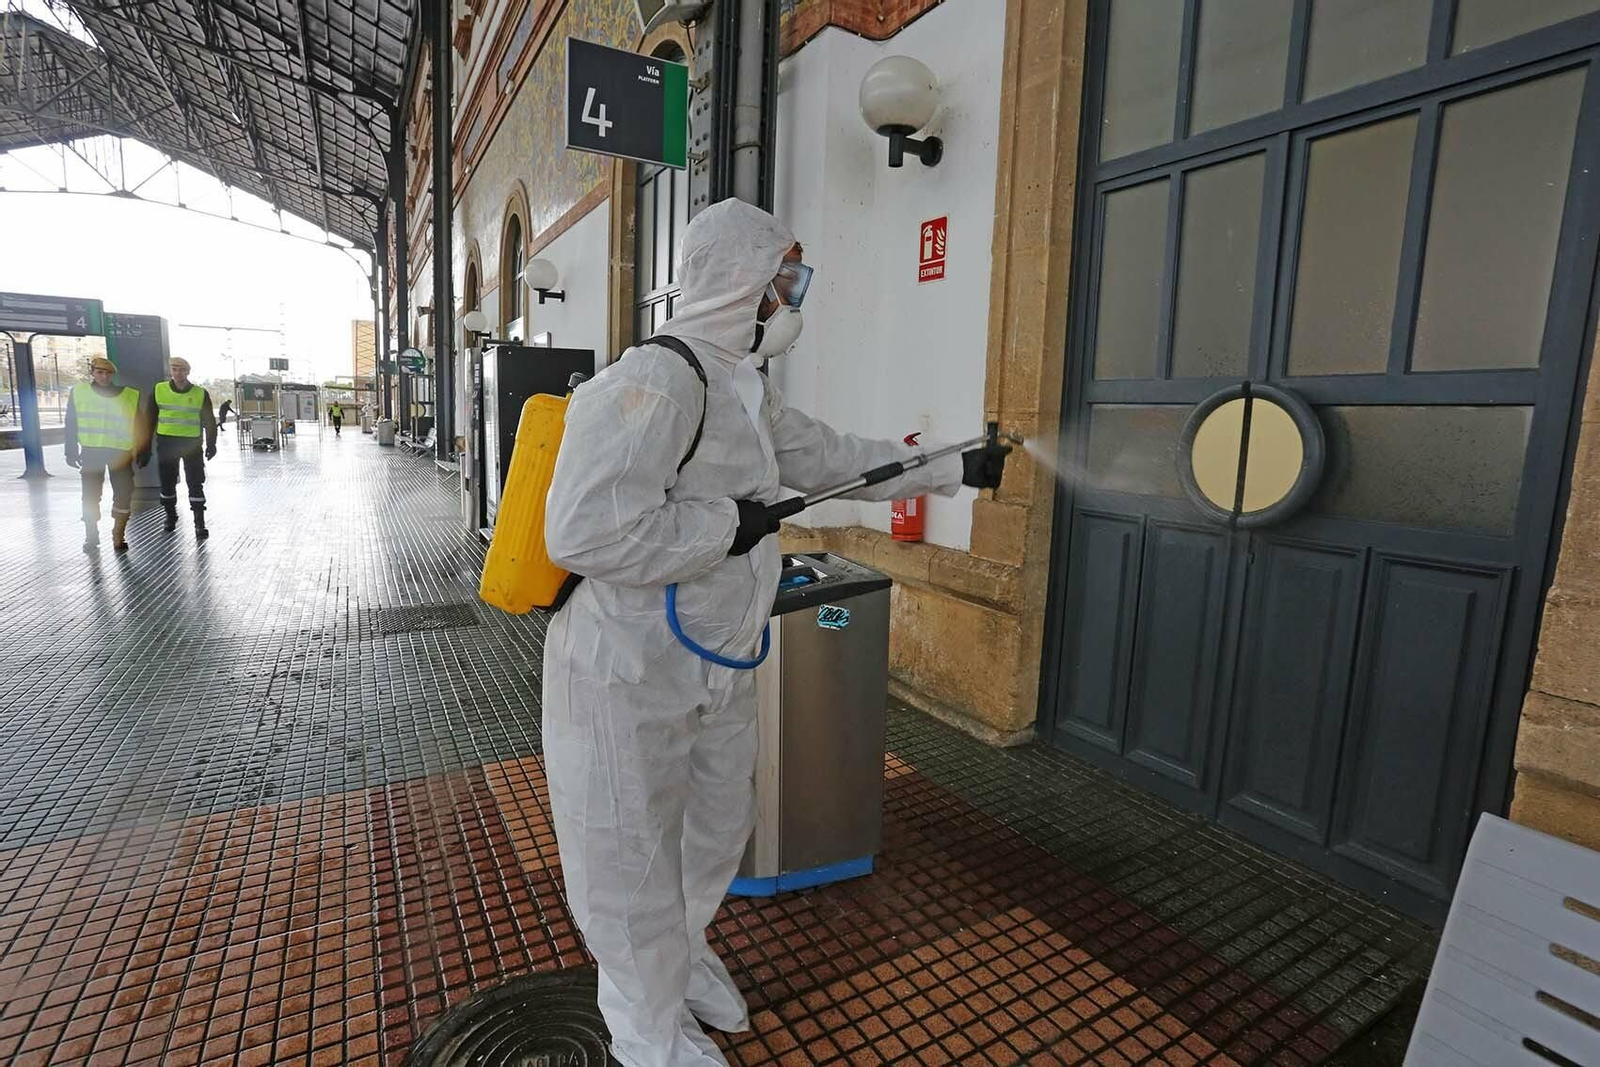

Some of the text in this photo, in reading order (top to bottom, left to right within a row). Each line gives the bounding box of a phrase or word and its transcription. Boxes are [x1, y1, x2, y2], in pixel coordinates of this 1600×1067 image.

[646, 65, 660, 77] Vía
[638, 75, 660, 85] PLATFORM
[581, 87, 613, 138] 4
[920, 265, 943, 278] EXTINTOR
[75, 315, 87, 329] 4
